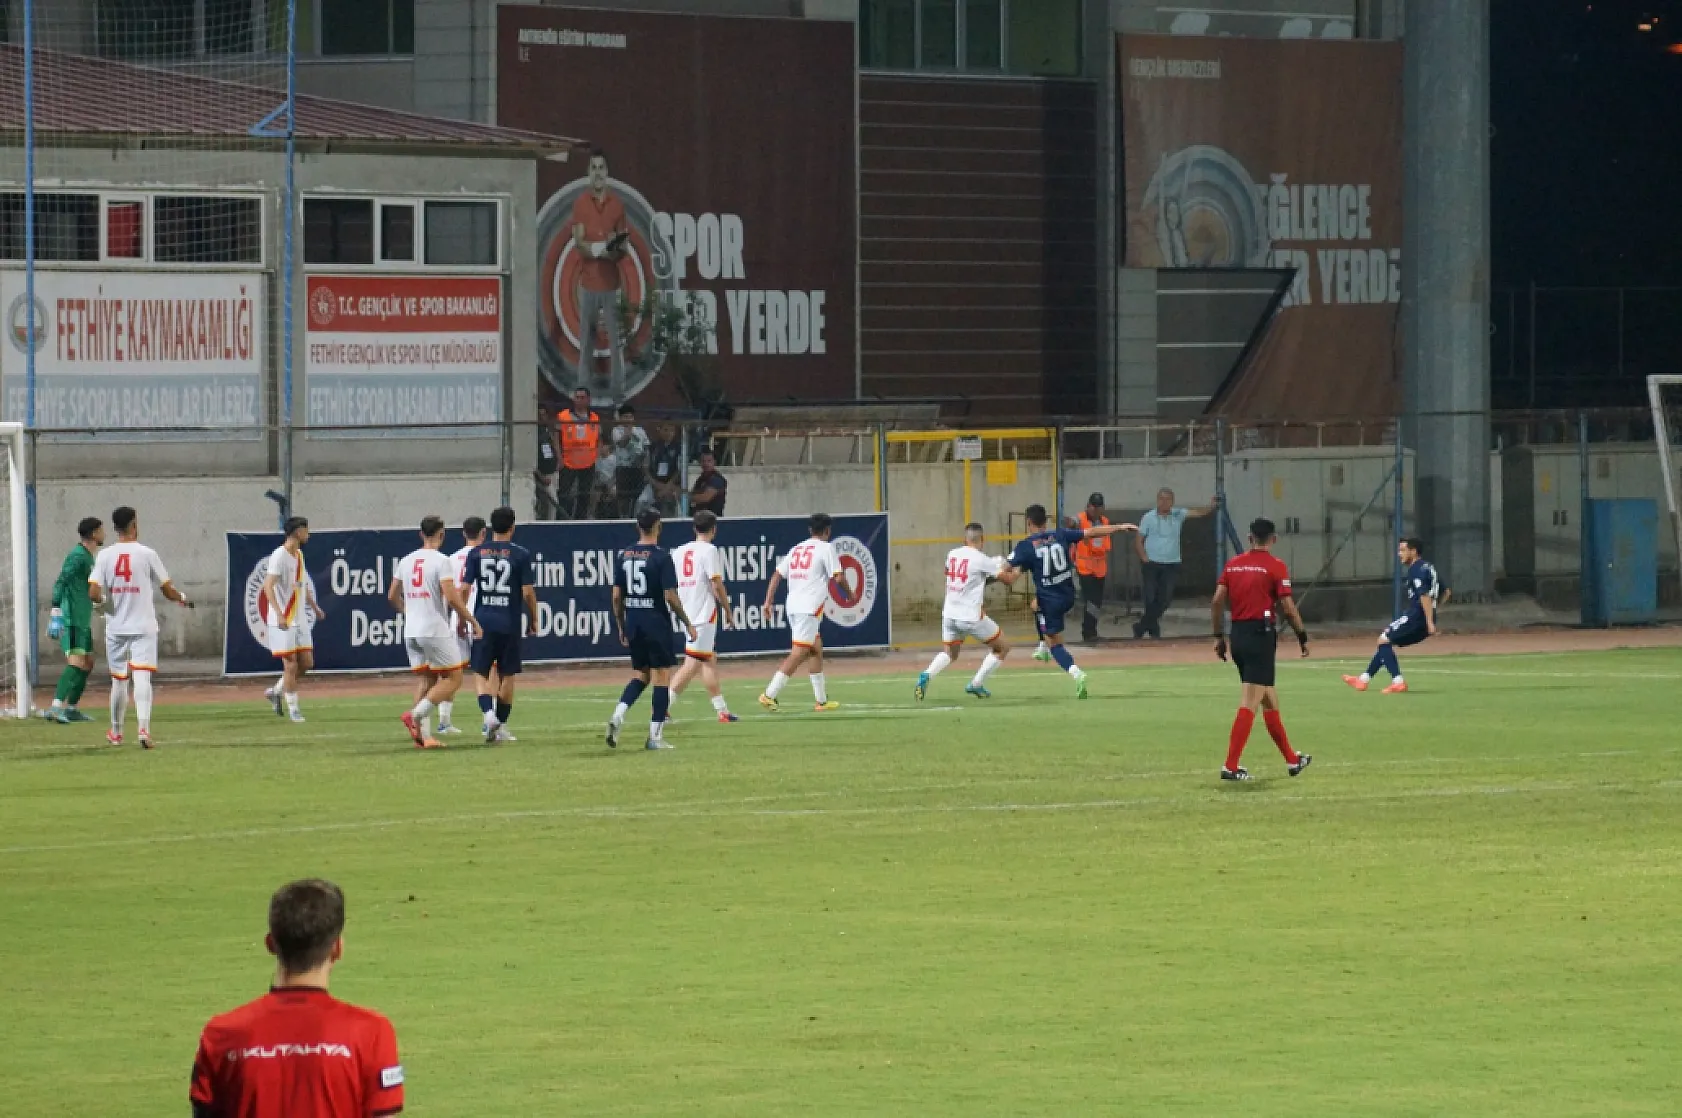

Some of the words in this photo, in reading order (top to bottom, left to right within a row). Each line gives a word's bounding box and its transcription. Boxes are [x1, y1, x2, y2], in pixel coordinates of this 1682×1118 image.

[649, 212, 746, 280] SPOR
[1317, 247, 1401, 304] YERDE
[56, 284, 123, 361] FETHİYE
[127, 283, 254, 361] KAYMAKAMLIĞI
[339, 296, 357, 315] T.C.
[358, 292, 401, 321] GENÇLİK
[404, 296, 417, 316] VE
[419, 296, 445, 316] SPOR
[446, 292, 496, 316] BAKANLIĞI
[725, 290, 827, 355] YERDE
[310, 339, 347, 365] FETHİYE
[347, 339, 384, 370] GENÇLİK
[384, 343, 397, 365] VE
[399, 343, 421, 365] SPOR
[422, 339, 440, 370] İLÇE
[441, 338, 497, 365] MÜDÜRLÜĞÜ
[8, 378, 66, 427] FEHİYE
[114, 553, 133, 583] 4
[331, 548, 383, 596] Özel
[411, 558, 425, 588] 5
[682, 549, 695, 578] 6
[790, 545, 816, 570] 55
[943, 556, 970, 583] 44
[1034, 542, 1068, 576] 70
[480, 558, 511, 594] 52
[622, 559, 648, 596] 15
